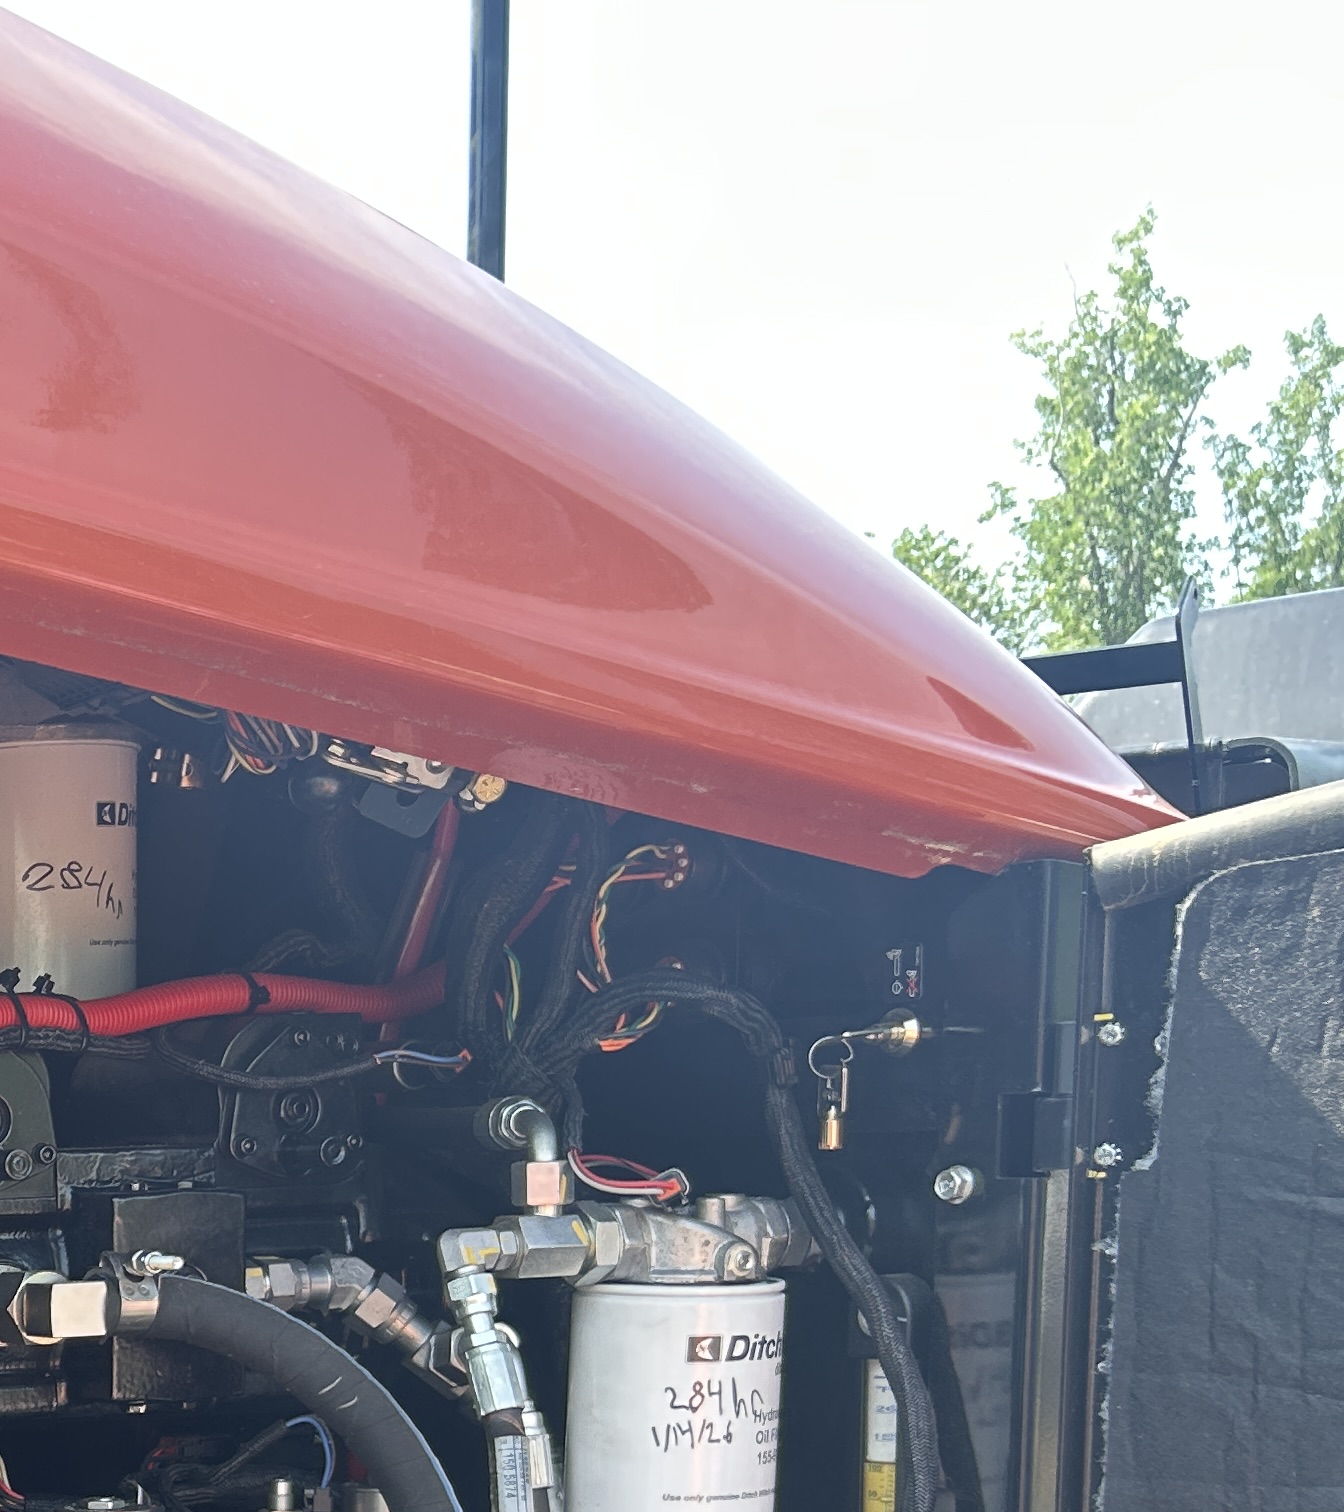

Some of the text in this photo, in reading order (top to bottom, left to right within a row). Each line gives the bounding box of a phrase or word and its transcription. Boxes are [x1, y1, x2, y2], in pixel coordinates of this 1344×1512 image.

[22, 861, 107, 908] 284
[725, 1330, 782, 1362] Ditch
[664, 1379, 724, 1416] 284
[662, 1493, 681, 1502] Use
[683, 1495, 704, 1503] only
